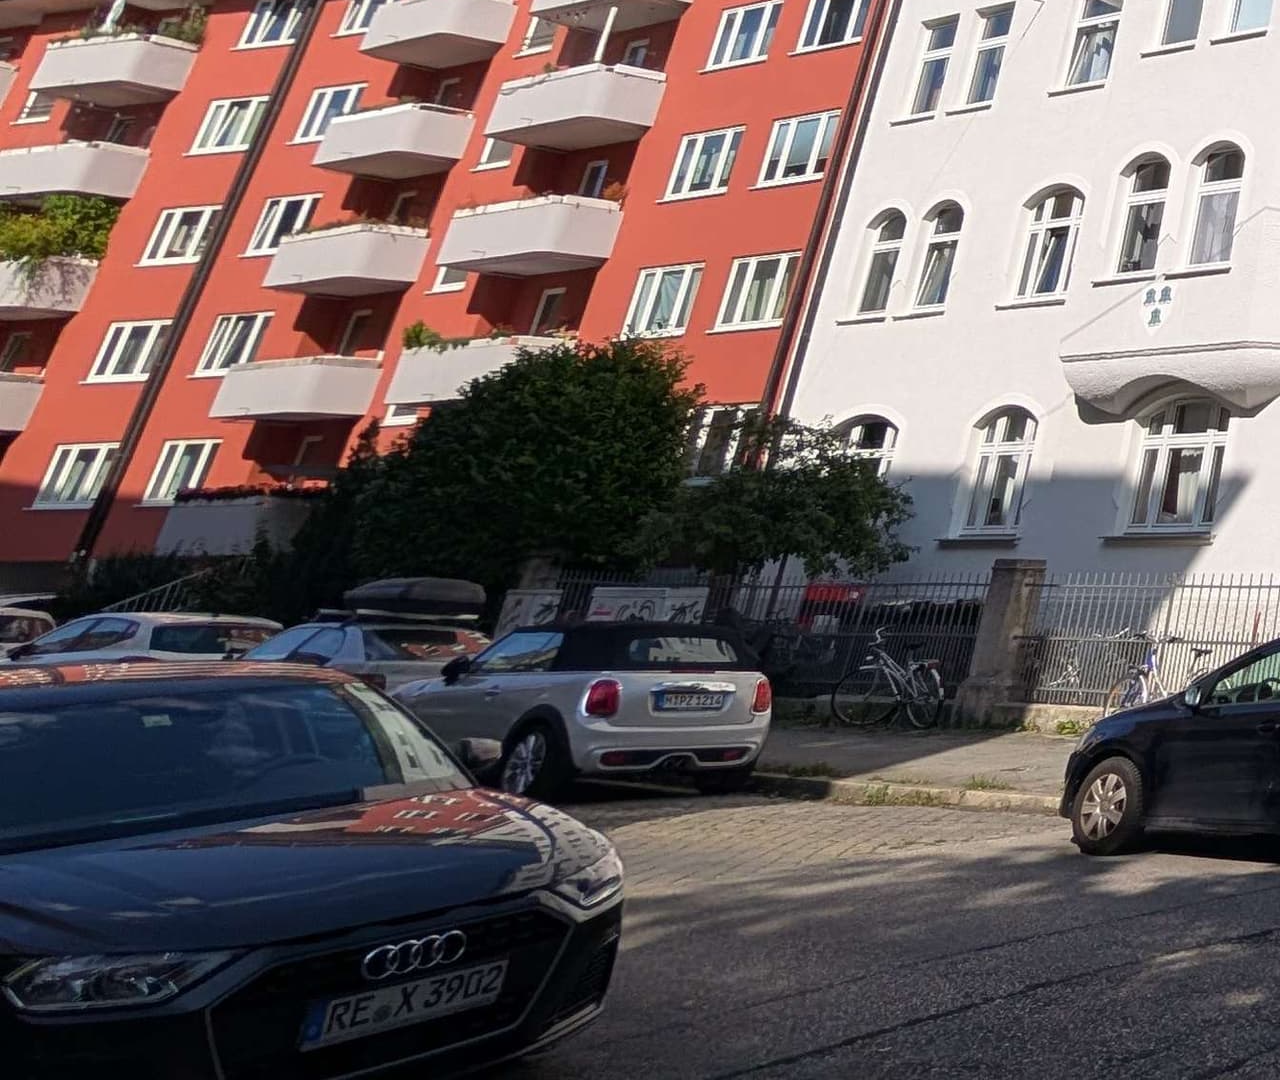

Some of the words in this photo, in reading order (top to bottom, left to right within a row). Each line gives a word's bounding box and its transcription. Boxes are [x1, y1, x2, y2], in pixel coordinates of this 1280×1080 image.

[326, 994, 376, 1033] RE
[393, 984, 419, 1017] X
[423, 967, 501, 1009] 3902
